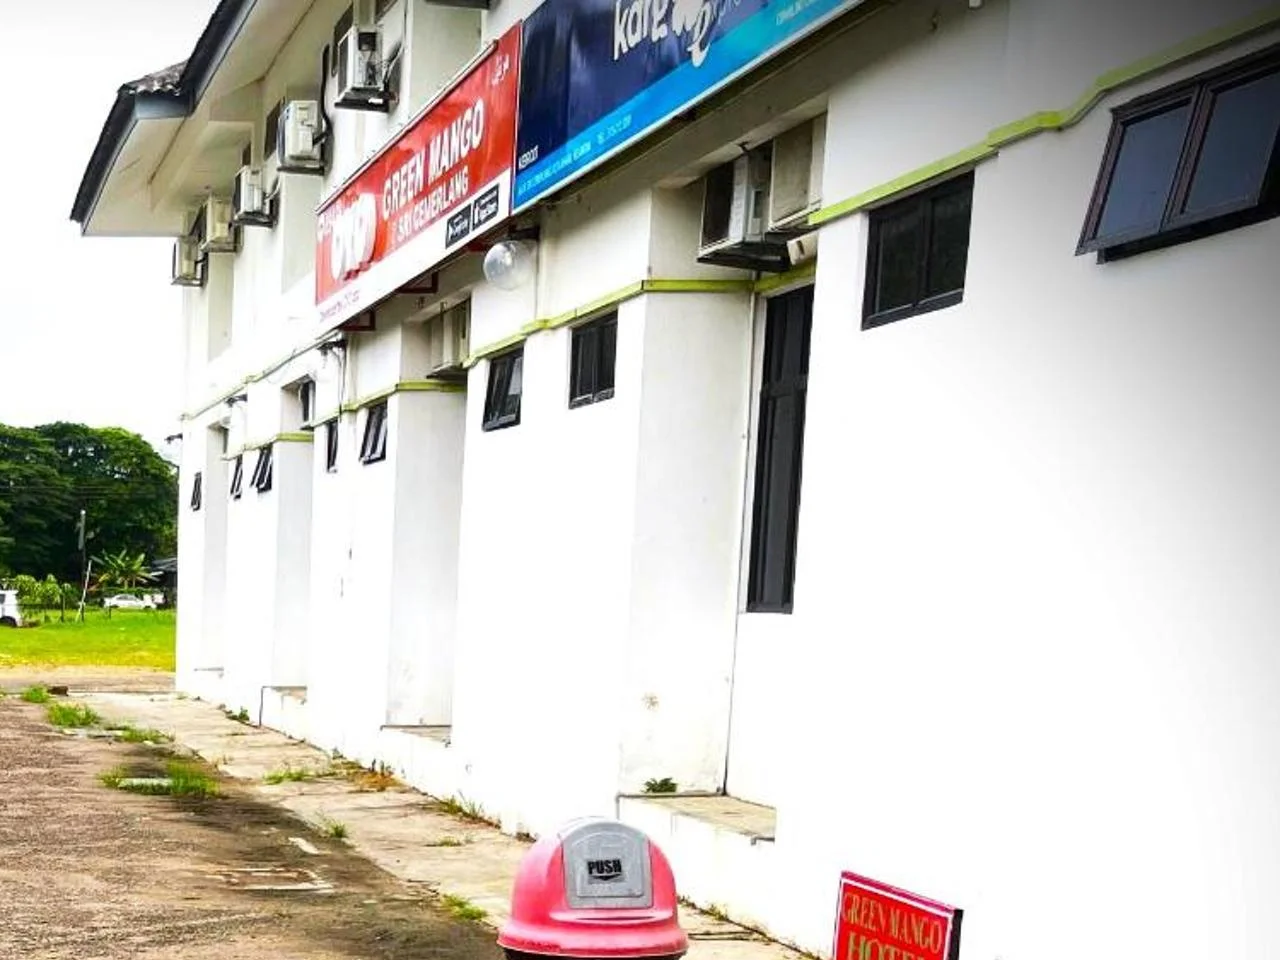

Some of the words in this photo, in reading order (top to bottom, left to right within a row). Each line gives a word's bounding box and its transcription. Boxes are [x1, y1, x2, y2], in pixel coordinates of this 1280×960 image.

[382, 151, 425, 220] GREEN
[427, 98, 486, 185] MANGO
[587, 859, 622, 875] PUSH
[842, 892, 889, 933] GREEN
[889, 907, 943, 954] MANGO
